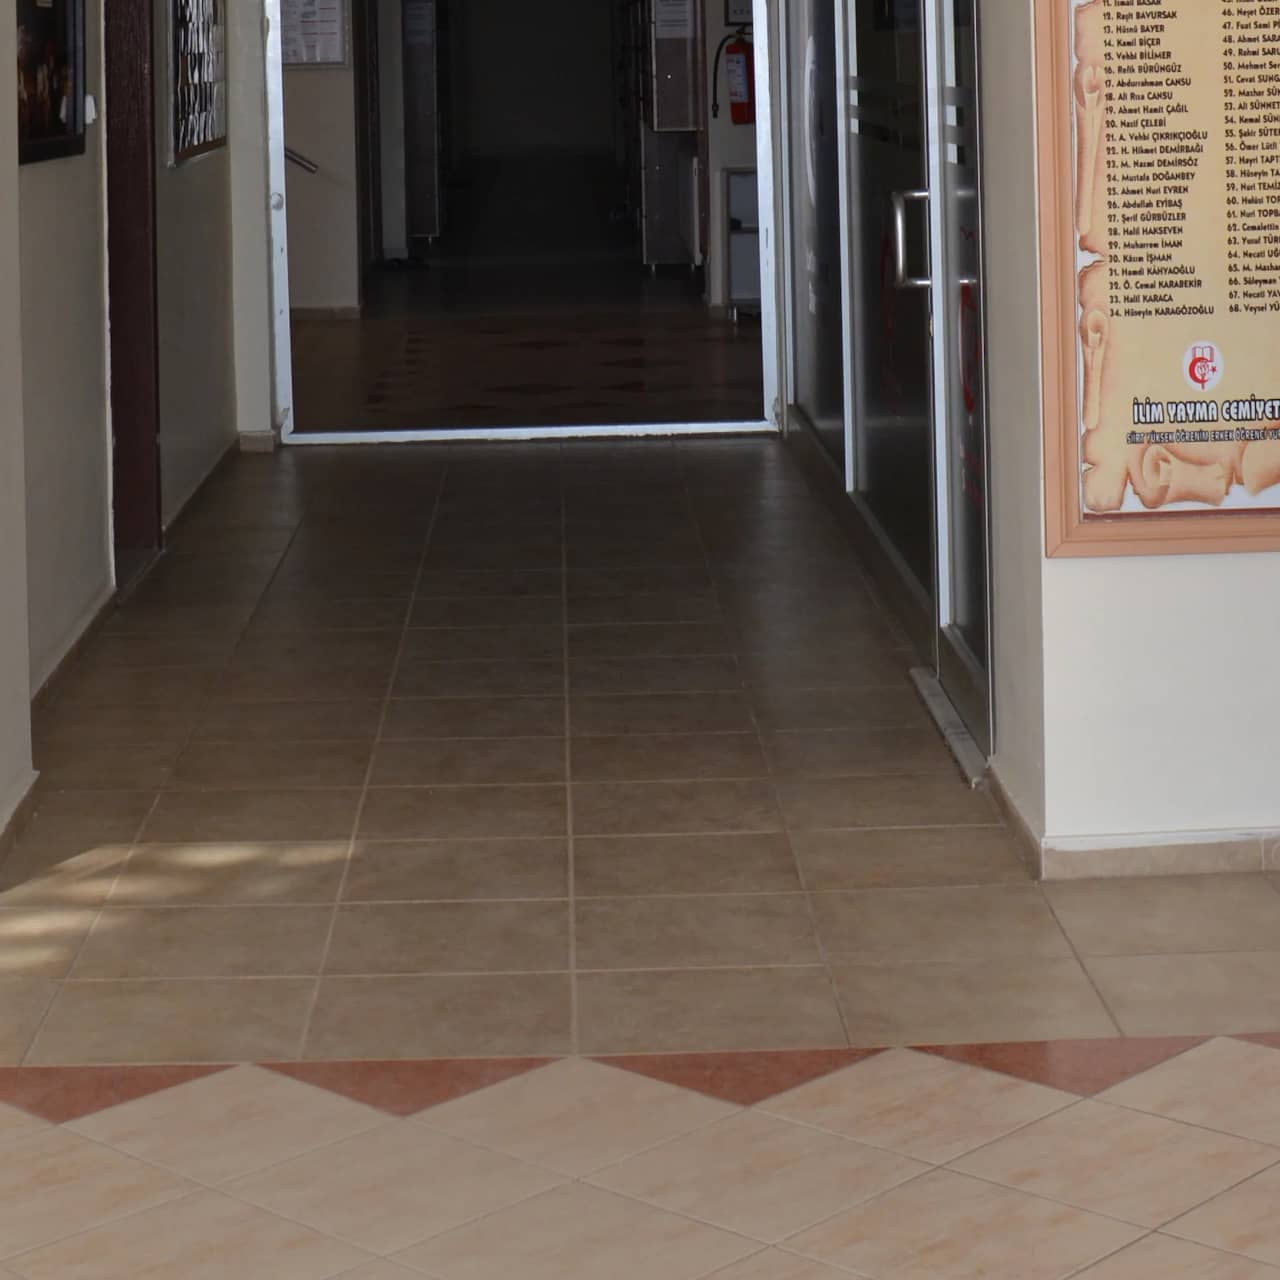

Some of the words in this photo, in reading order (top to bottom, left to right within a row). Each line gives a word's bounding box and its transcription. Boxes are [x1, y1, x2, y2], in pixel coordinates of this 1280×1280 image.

[1133, 397, 1164, 424] İLİM
[1167, 400, 1218, 423] YAYMA
[1210, 429, 1234, 441] ERKEK
